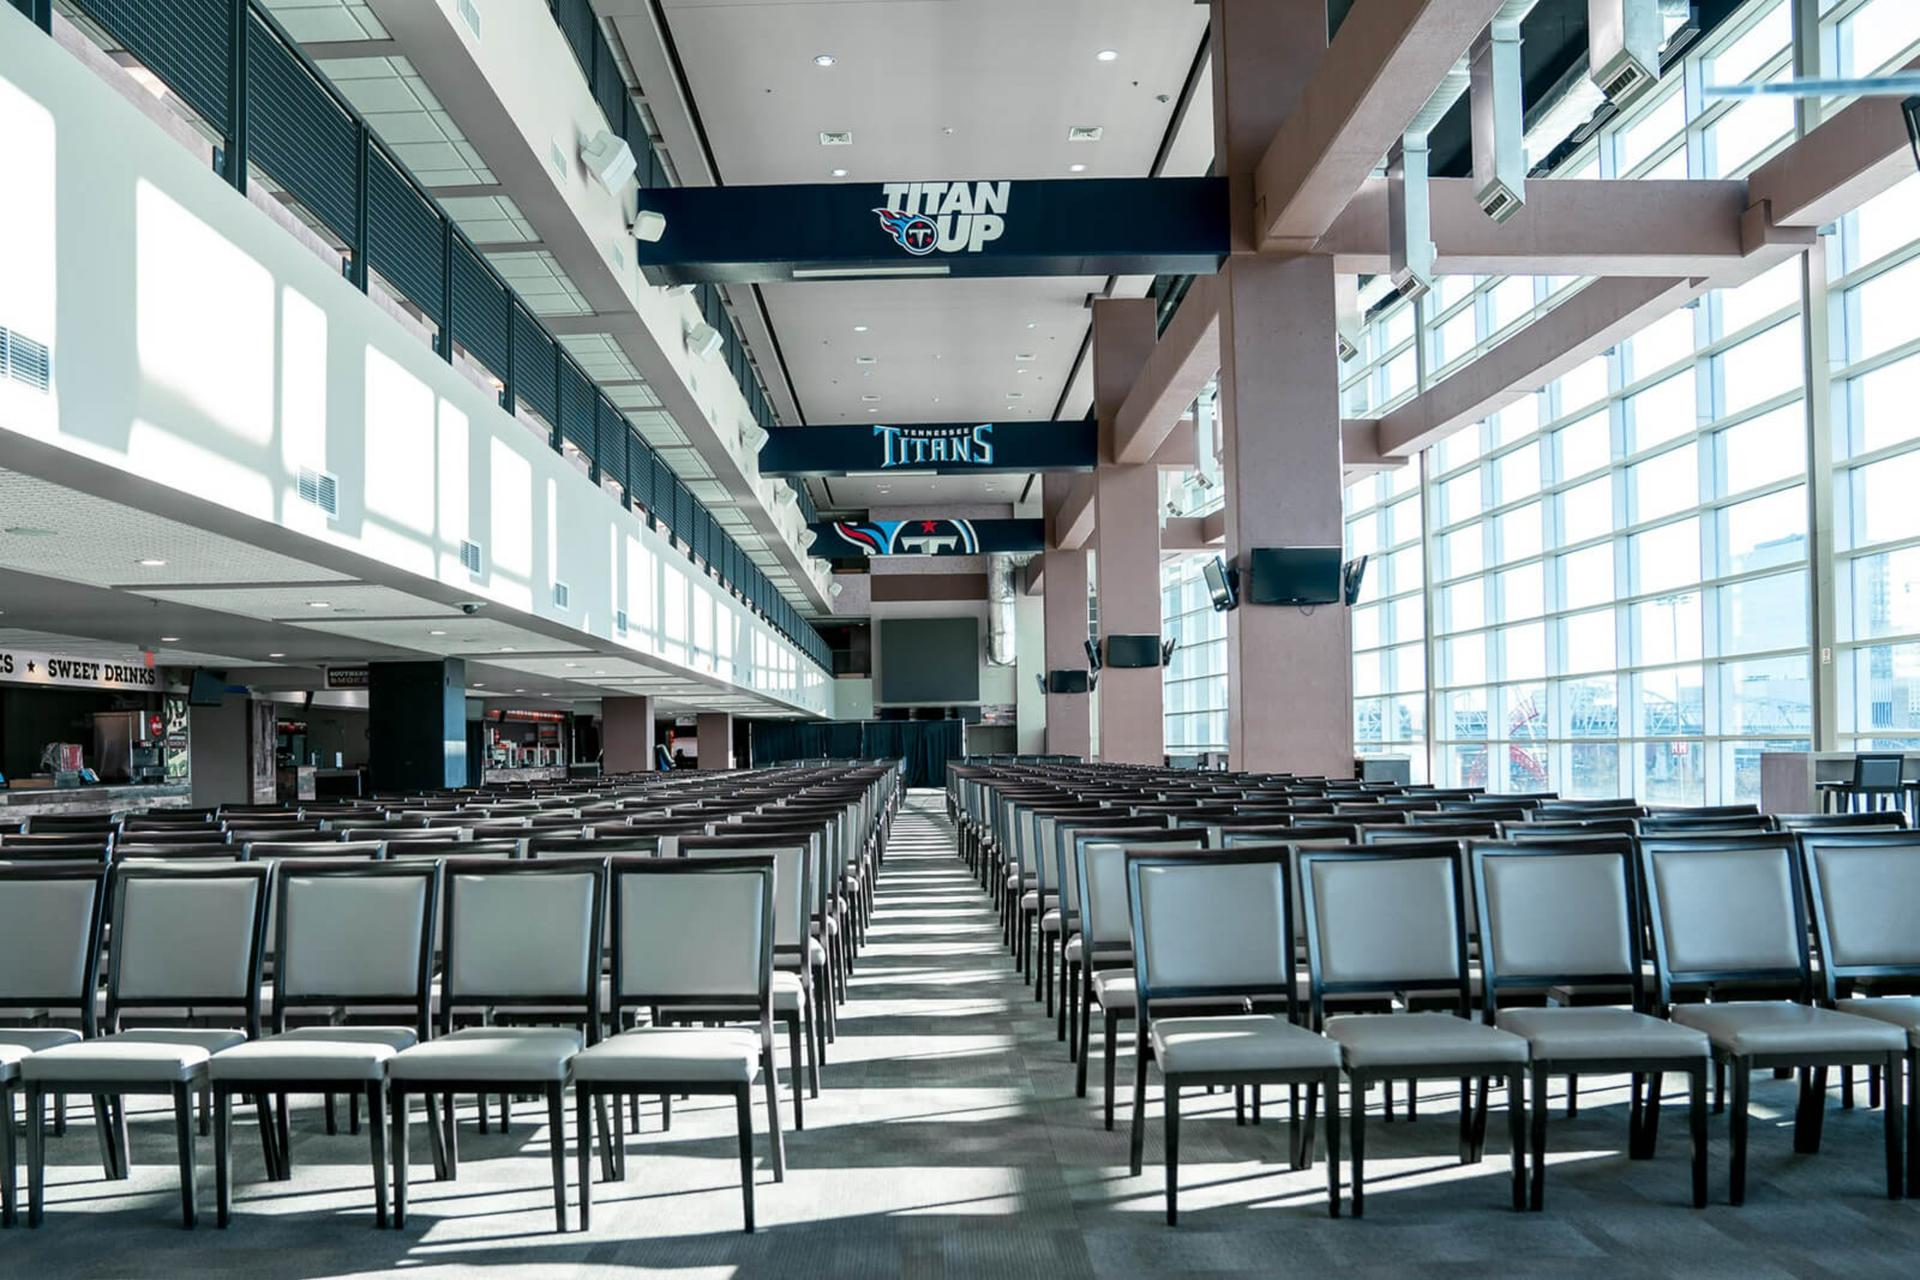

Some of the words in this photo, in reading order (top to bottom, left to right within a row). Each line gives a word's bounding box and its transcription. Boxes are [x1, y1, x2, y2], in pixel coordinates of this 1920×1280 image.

[883, 181, 1010, 215] TITAN
[937, 214, 1005, 252] UP
[873, 424, 993, 468] TITANS
[904, 428, 969, 436] TENNESSEE
[0, 654, 14, 673] S
[48, 659, 99, 681] SWEET
[104, 664, 155, 685] DRINKS
